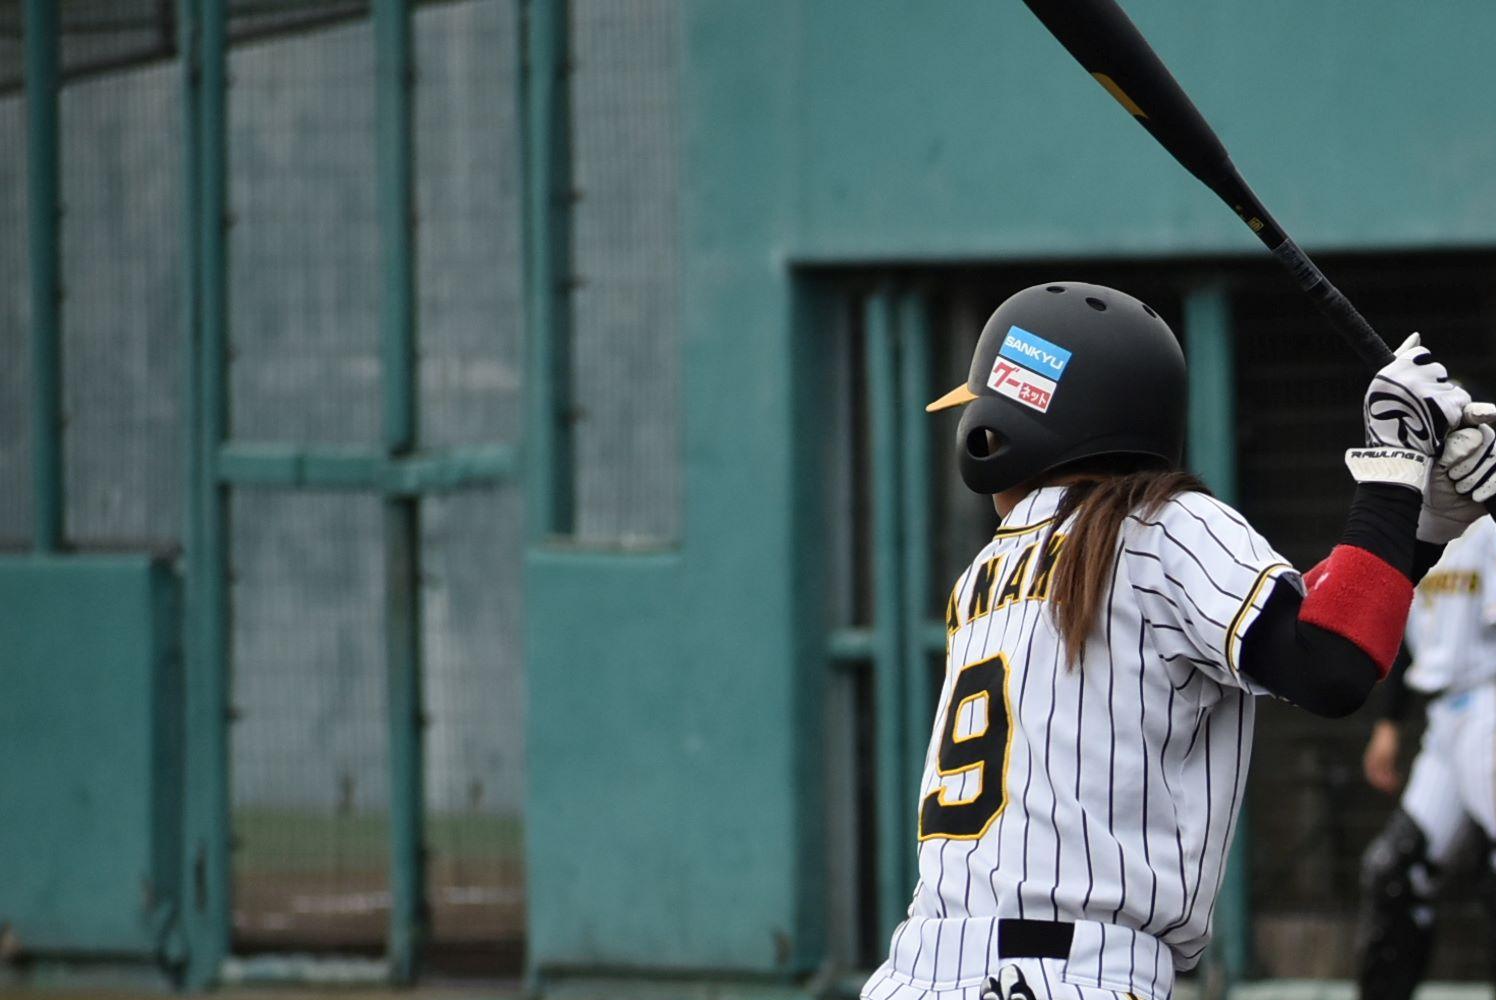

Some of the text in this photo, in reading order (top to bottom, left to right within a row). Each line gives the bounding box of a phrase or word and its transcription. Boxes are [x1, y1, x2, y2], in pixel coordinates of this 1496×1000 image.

[1005, 335, 1064, 370] SANKYU
[1351, 451, 1425, 463] RAWLINGS
[918, 652, 1014, 841] 9
